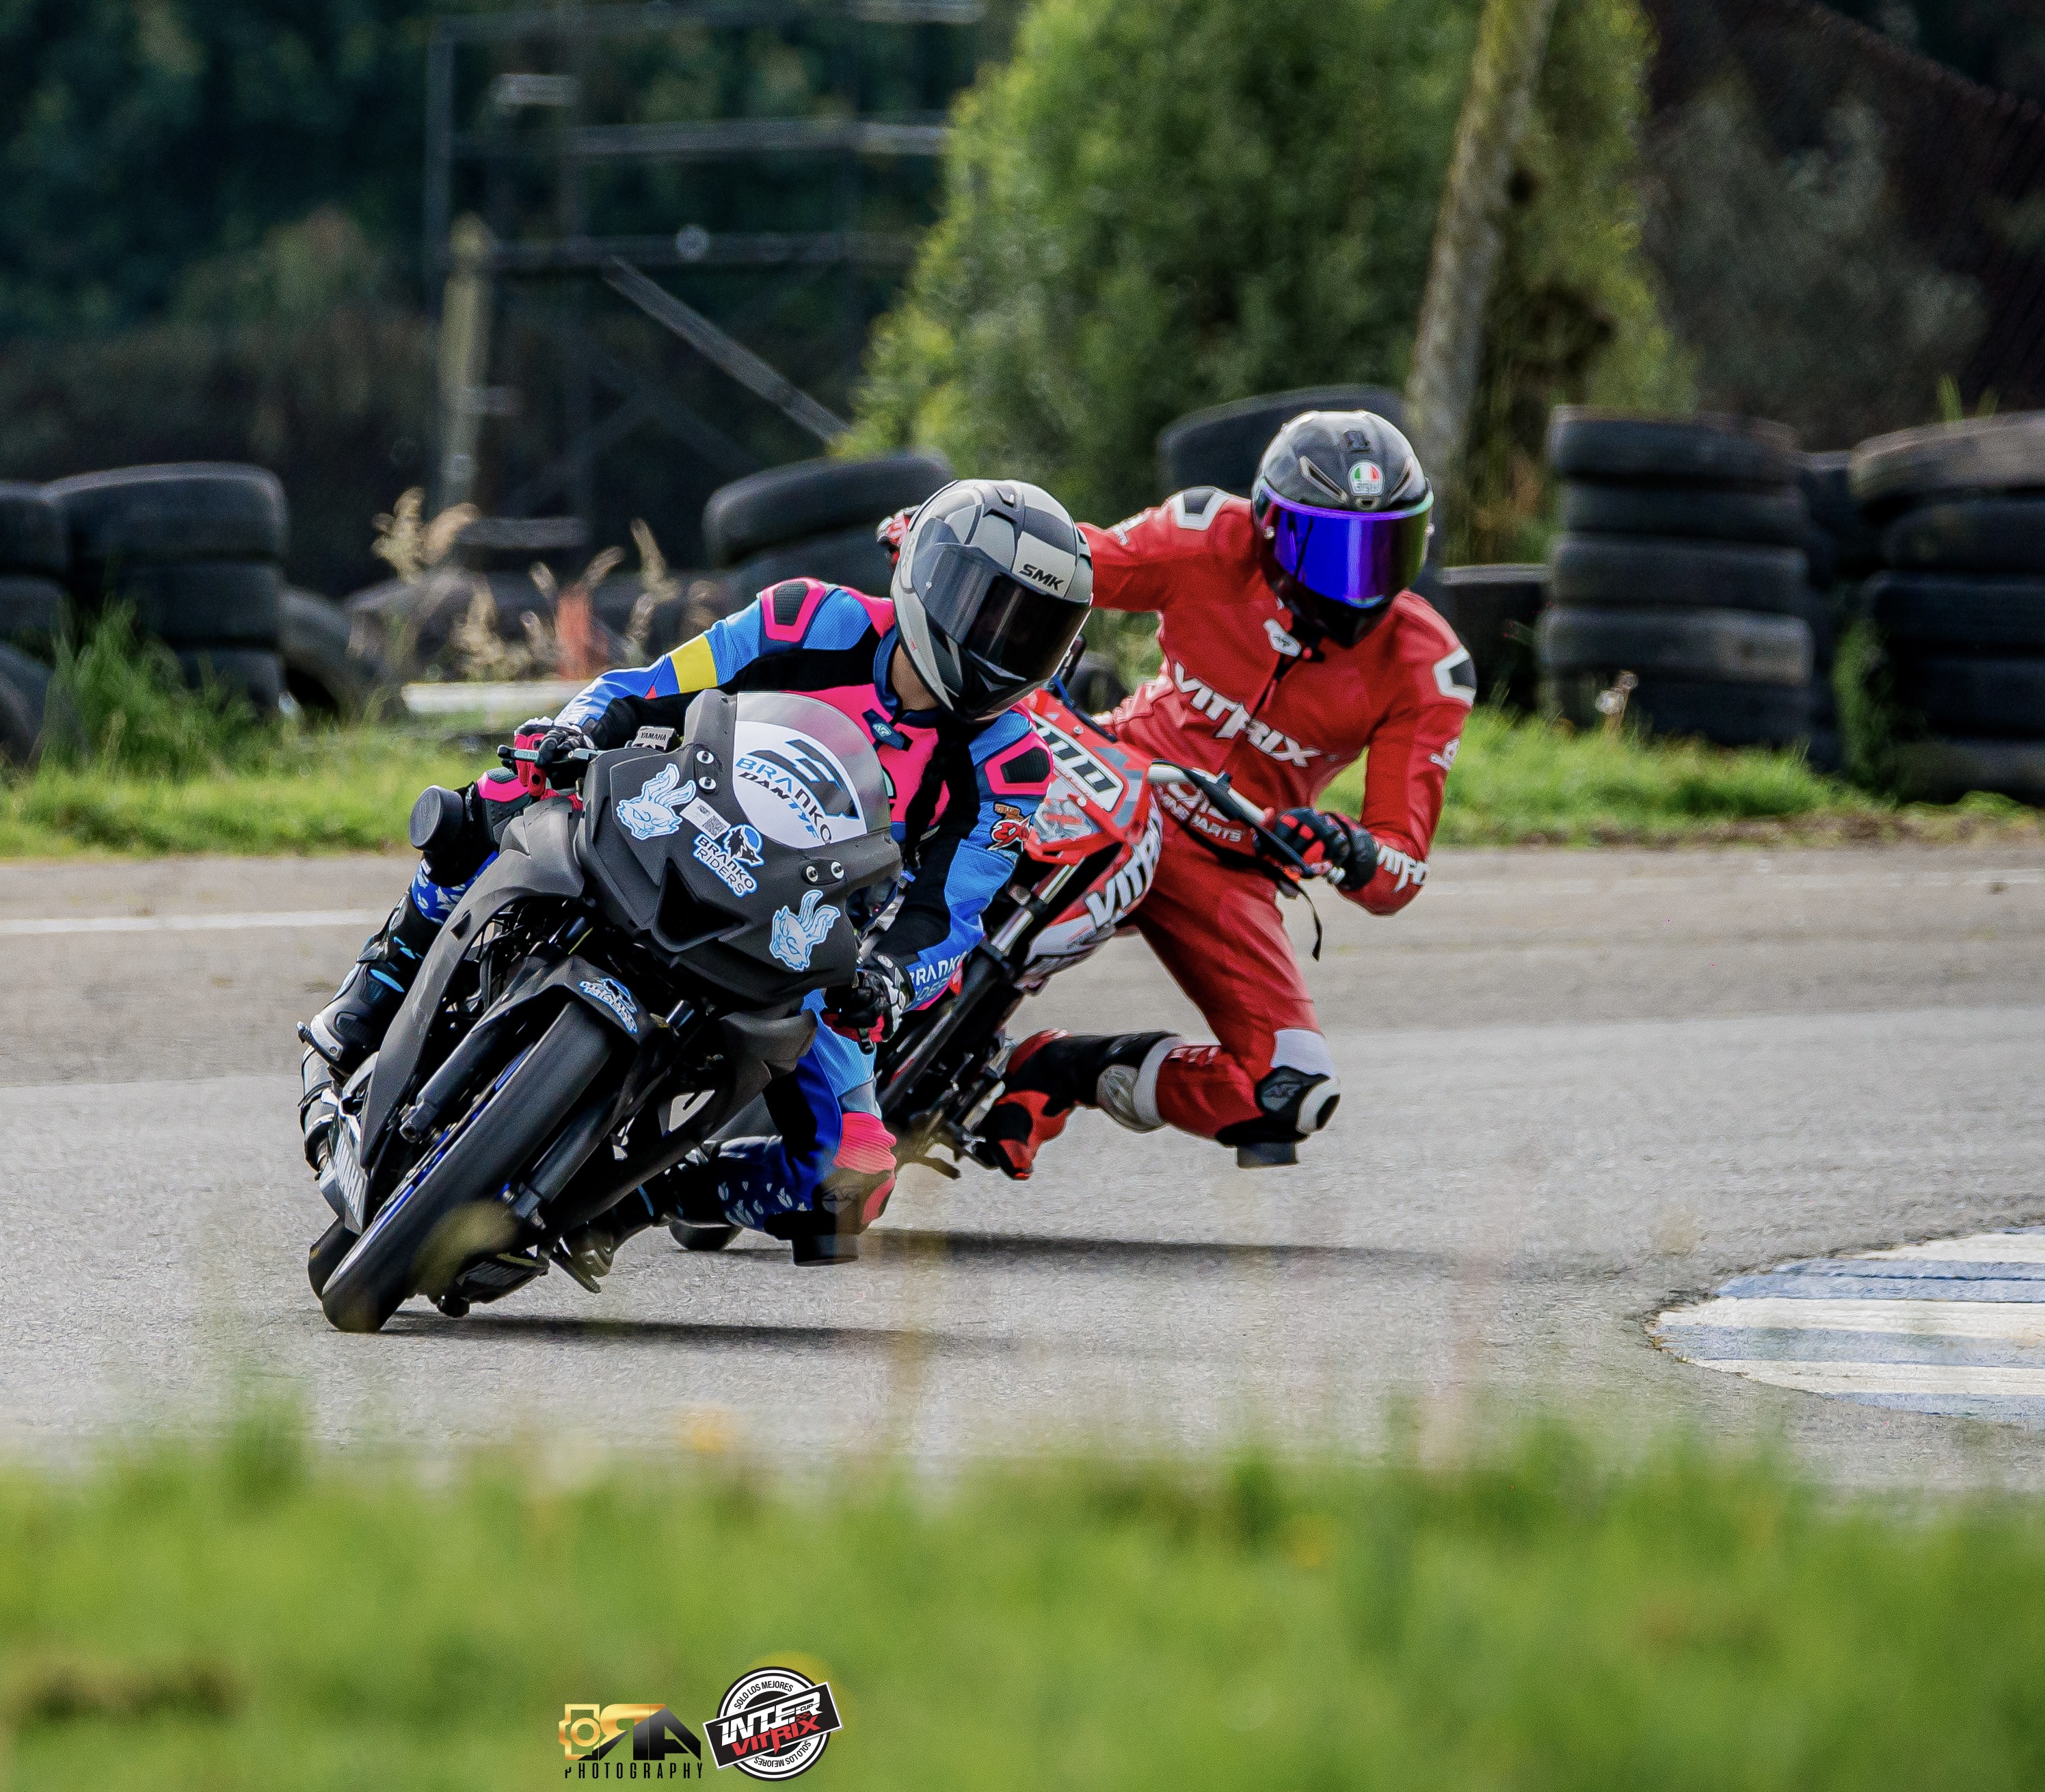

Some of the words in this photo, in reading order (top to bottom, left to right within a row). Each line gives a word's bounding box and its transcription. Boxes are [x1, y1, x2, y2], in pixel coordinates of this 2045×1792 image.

[1019, 563, 1065, 591] SMK
[641, 732, 667, 741] YAMAHA
[1173, 660, 1322, 768] VITRIX
[736, 758, 832, 844] BRANKO
[697, 836, 754, 889] BRANKO
[697, 848, 745, 894] RIDERS
